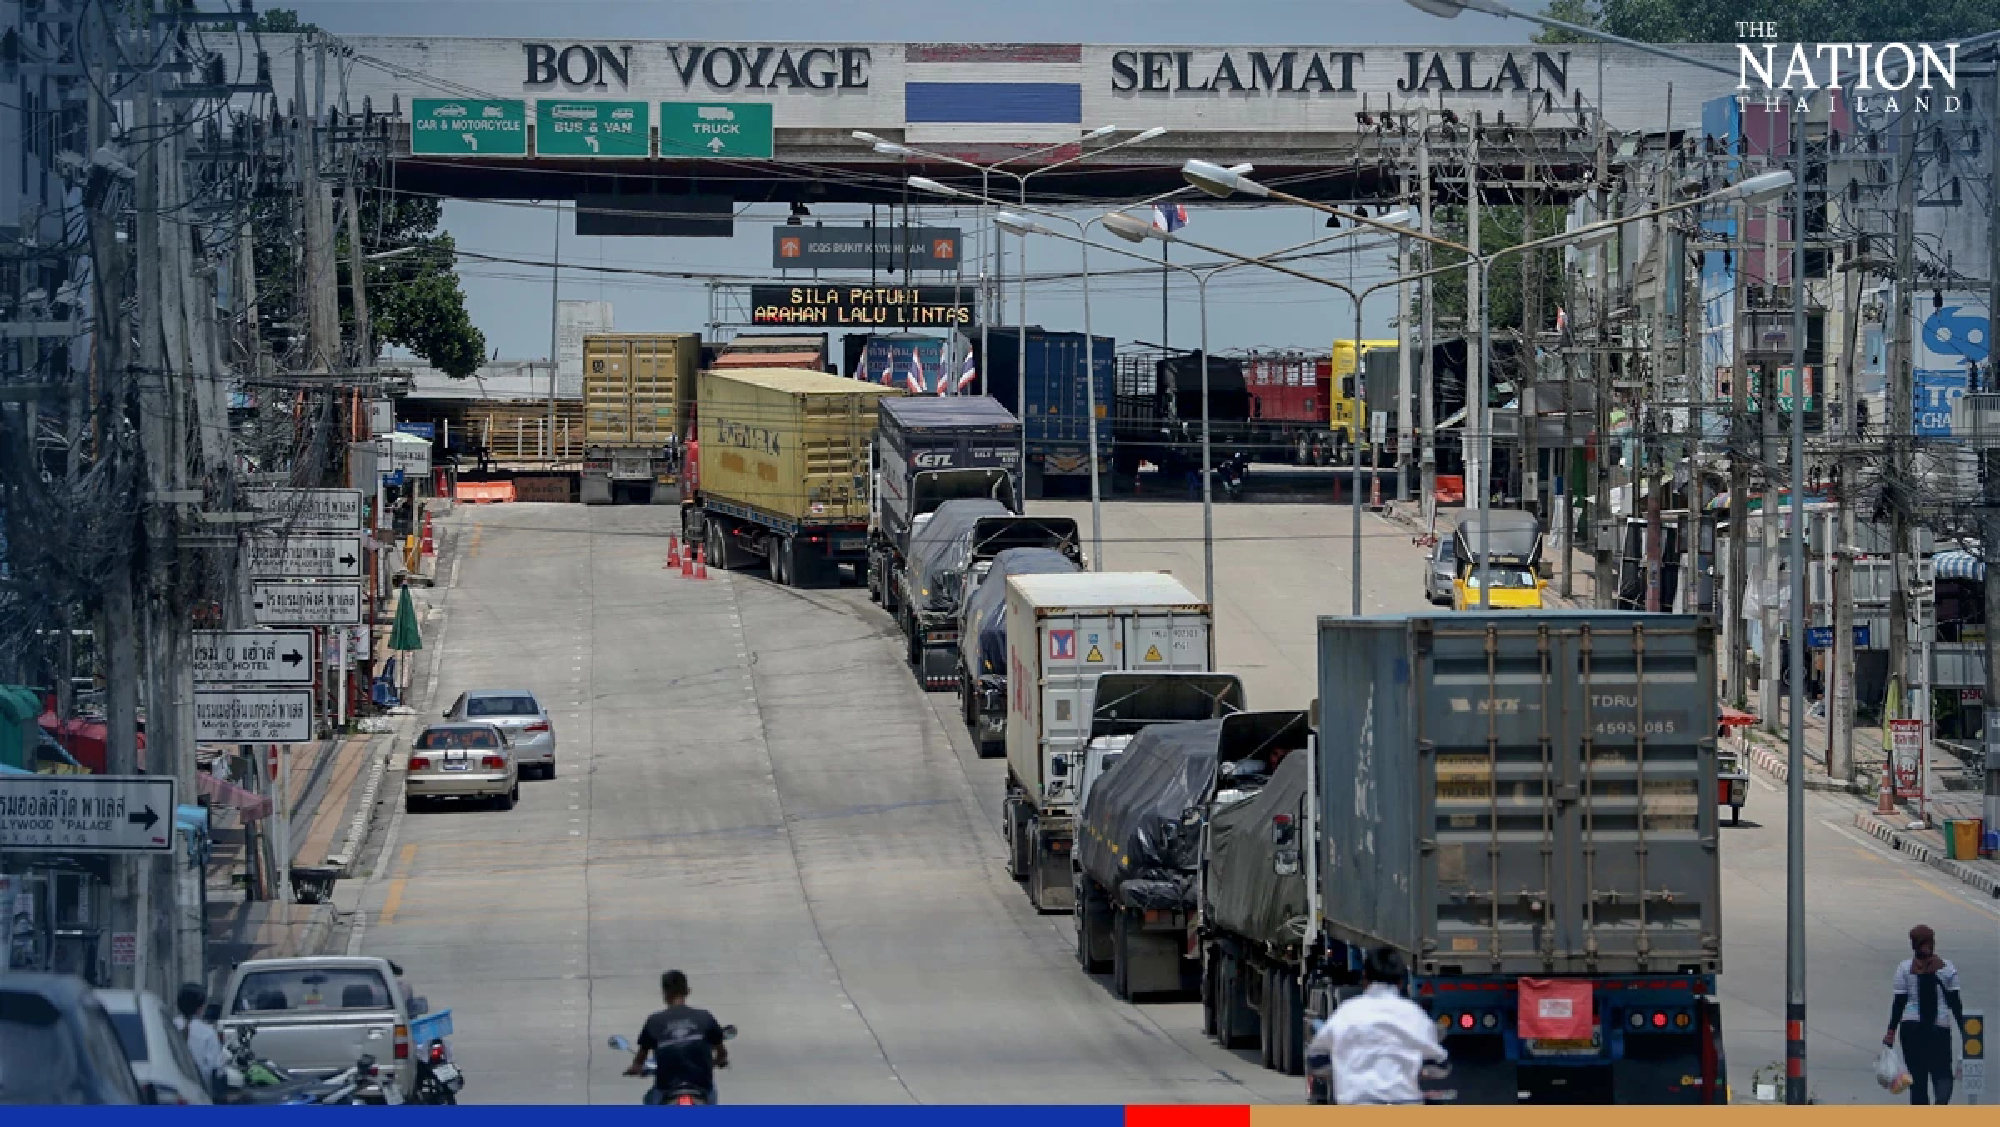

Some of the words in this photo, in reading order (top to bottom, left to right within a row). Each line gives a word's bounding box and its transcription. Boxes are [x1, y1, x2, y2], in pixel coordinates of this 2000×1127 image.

[523, 44, 632, 87] BON
[667, 46, 871, 90] VOYAGE
[1111, 51, 1365, 92] SELAMAT
[1397, 51, 1573, 93] JALAN
[416, 119, 438, 131] CAR
[451, 119, 521, 131] MOTORCYCLE
[554, 121, 583, 133] BUS
[604, 122, 633, 133] VAN
[692, 123, 741, 134] TRUCK
[893, 244, 926, 254] HIAM
[791, 288, 839, 304] SILA
[851, 289, 919, 304] PATUHI
[754, 306, 826, 322] ARAHAN
[838, 307, 886, 322] LALU
[898, 307, 969, 323] LINTAS
[233, 662, 270, 670] HOTEL
[1591, 694, 1638, 708] TDRU
[232, 719, 259, 730] Grand
[261, 719, 292, 730] Palace
[0, 819, 54, 830] LYWOOD
[67, 819, 113, 830] PALACE
